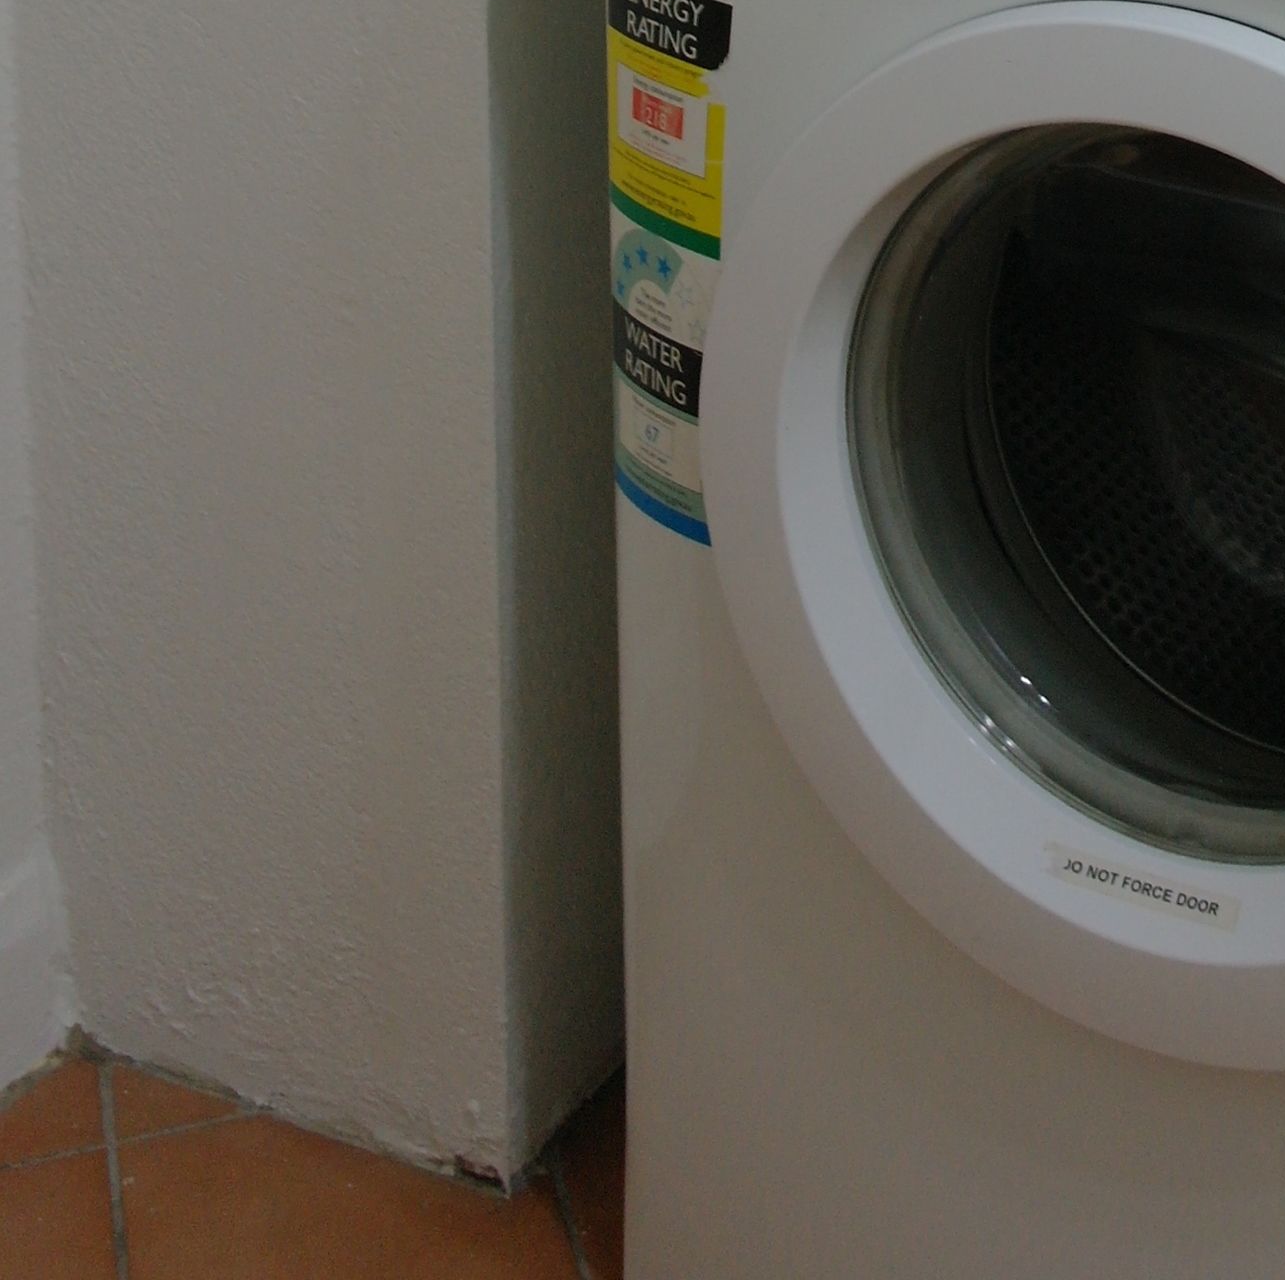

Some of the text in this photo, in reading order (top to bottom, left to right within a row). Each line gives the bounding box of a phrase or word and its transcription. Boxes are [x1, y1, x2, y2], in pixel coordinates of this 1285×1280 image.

[627, 9, 698, 60] RATING
[624, 316, 684, 373] WATER
[625, 348, 687, 406] RATING
[1086, 865, 1119, 886] NOT
[1122, 876, 1173, 903] FORCE
[1176, 892, 1219, 916] DOOR
